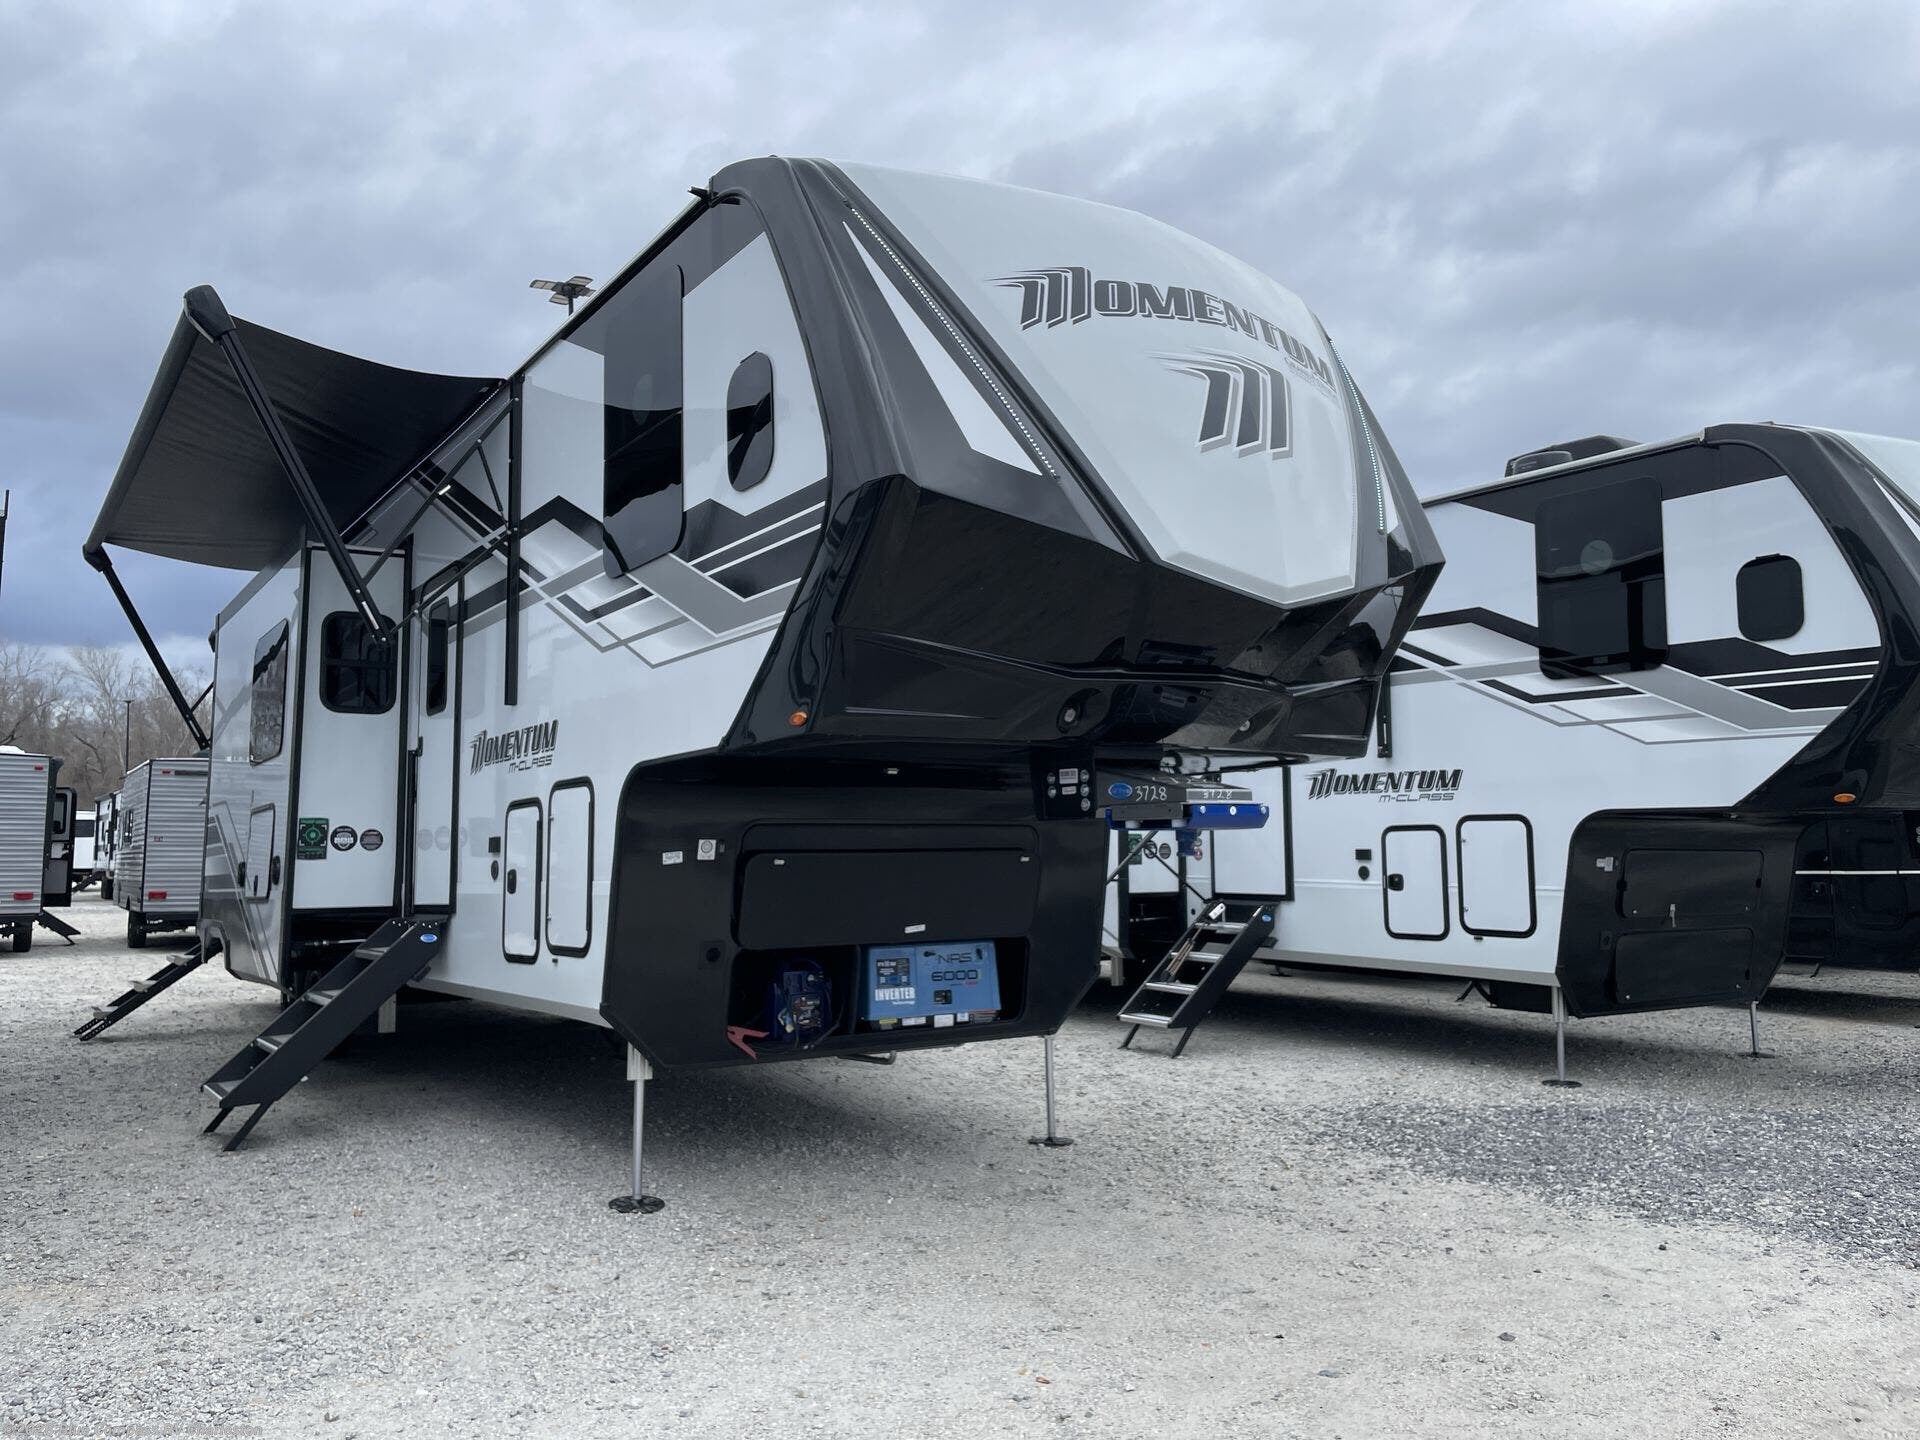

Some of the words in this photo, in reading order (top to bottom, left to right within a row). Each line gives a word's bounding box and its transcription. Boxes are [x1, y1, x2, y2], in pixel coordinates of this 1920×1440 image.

[986, 267, 1338, 392] MOMENTUM
[470, 719, 559, 775] MOMENTUM
[1134, 785, 1168, 801] 3728
[1306, 768, 1463, 800] MOMENTUM
[931, 969, 979, 981] 6000
[874, 987, 916, 1001] INVERTER
